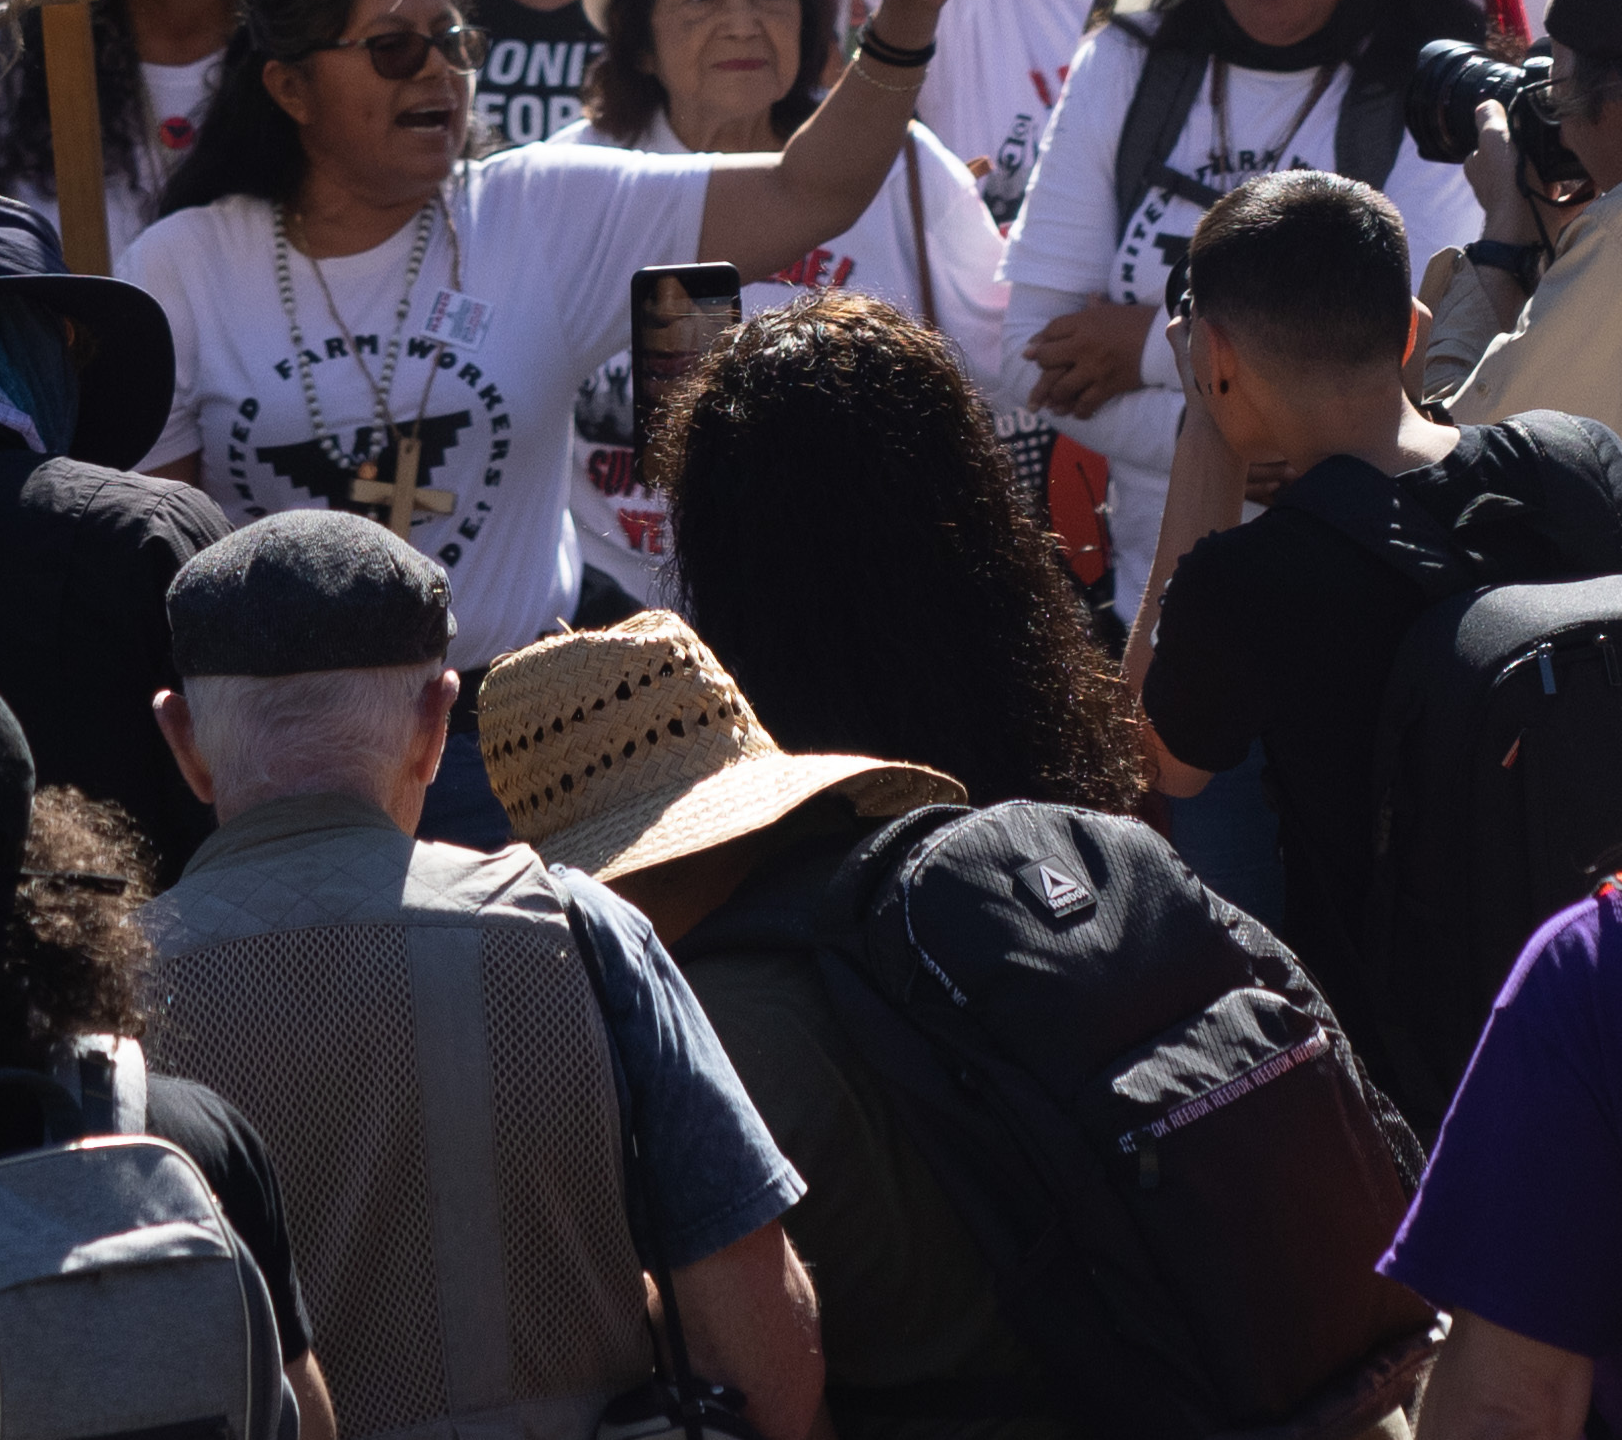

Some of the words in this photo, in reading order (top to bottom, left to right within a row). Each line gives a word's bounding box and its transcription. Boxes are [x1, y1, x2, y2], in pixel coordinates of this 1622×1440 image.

[478, 38, 605, 87] ONI
[273, 333, 378, 382] FARM
[407, 337, 511, 488] WORKERS
[1048, 885, 1090, 911] Reebok
[1117, 1118, 1173, 1154] REOK
[1169, 1095, 1212, 1129] REEBOK
[1211, 1076, 1255, 1109] REEBOK
[1254, 1054, 1293, 1087] REEBOK
